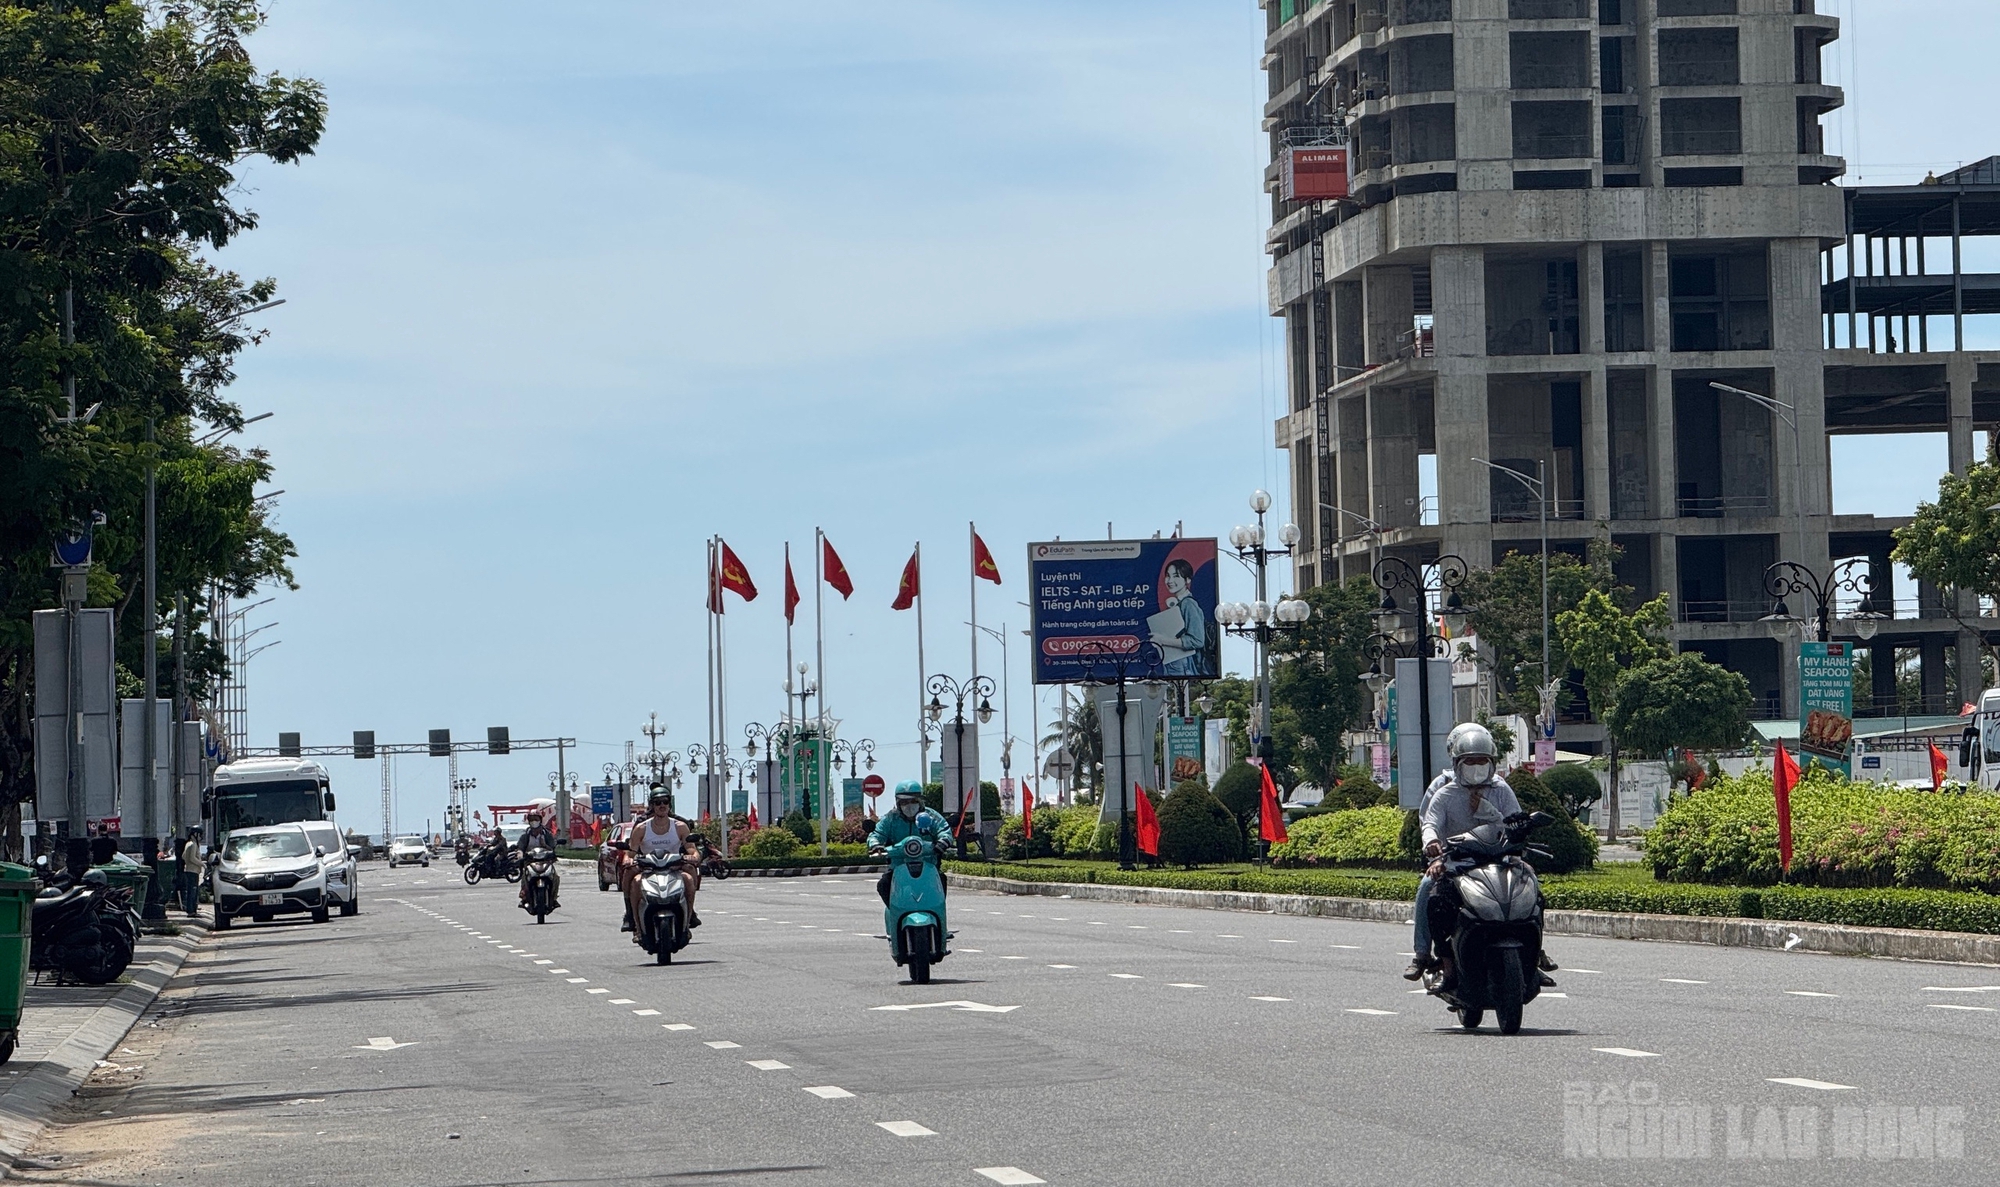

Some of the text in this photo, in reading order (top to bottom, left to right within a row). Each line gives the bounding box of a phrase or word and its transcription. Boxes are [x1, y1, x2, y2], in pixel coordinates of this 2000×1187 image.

[1041, 572, 1081, 582] Luyện thi
[1041, 586, 1070, 596] IELTS
[1080, 585, 1102, 596] SAT
[1112, 584, 1124, 594] IB
[1134, 584, 1150, 594] AP
[1042, 596, 1145, 612] Tiếng Anh giao tiếp
[1062, 640, 1089, 650] 0902
[1106, 640, 1120, 649] 02
[1121, 639, 1134, 648] 68
[1804, 657, 1849, 667] MY HANH
[1804, 668, 1849, 677] SEAFOOD
